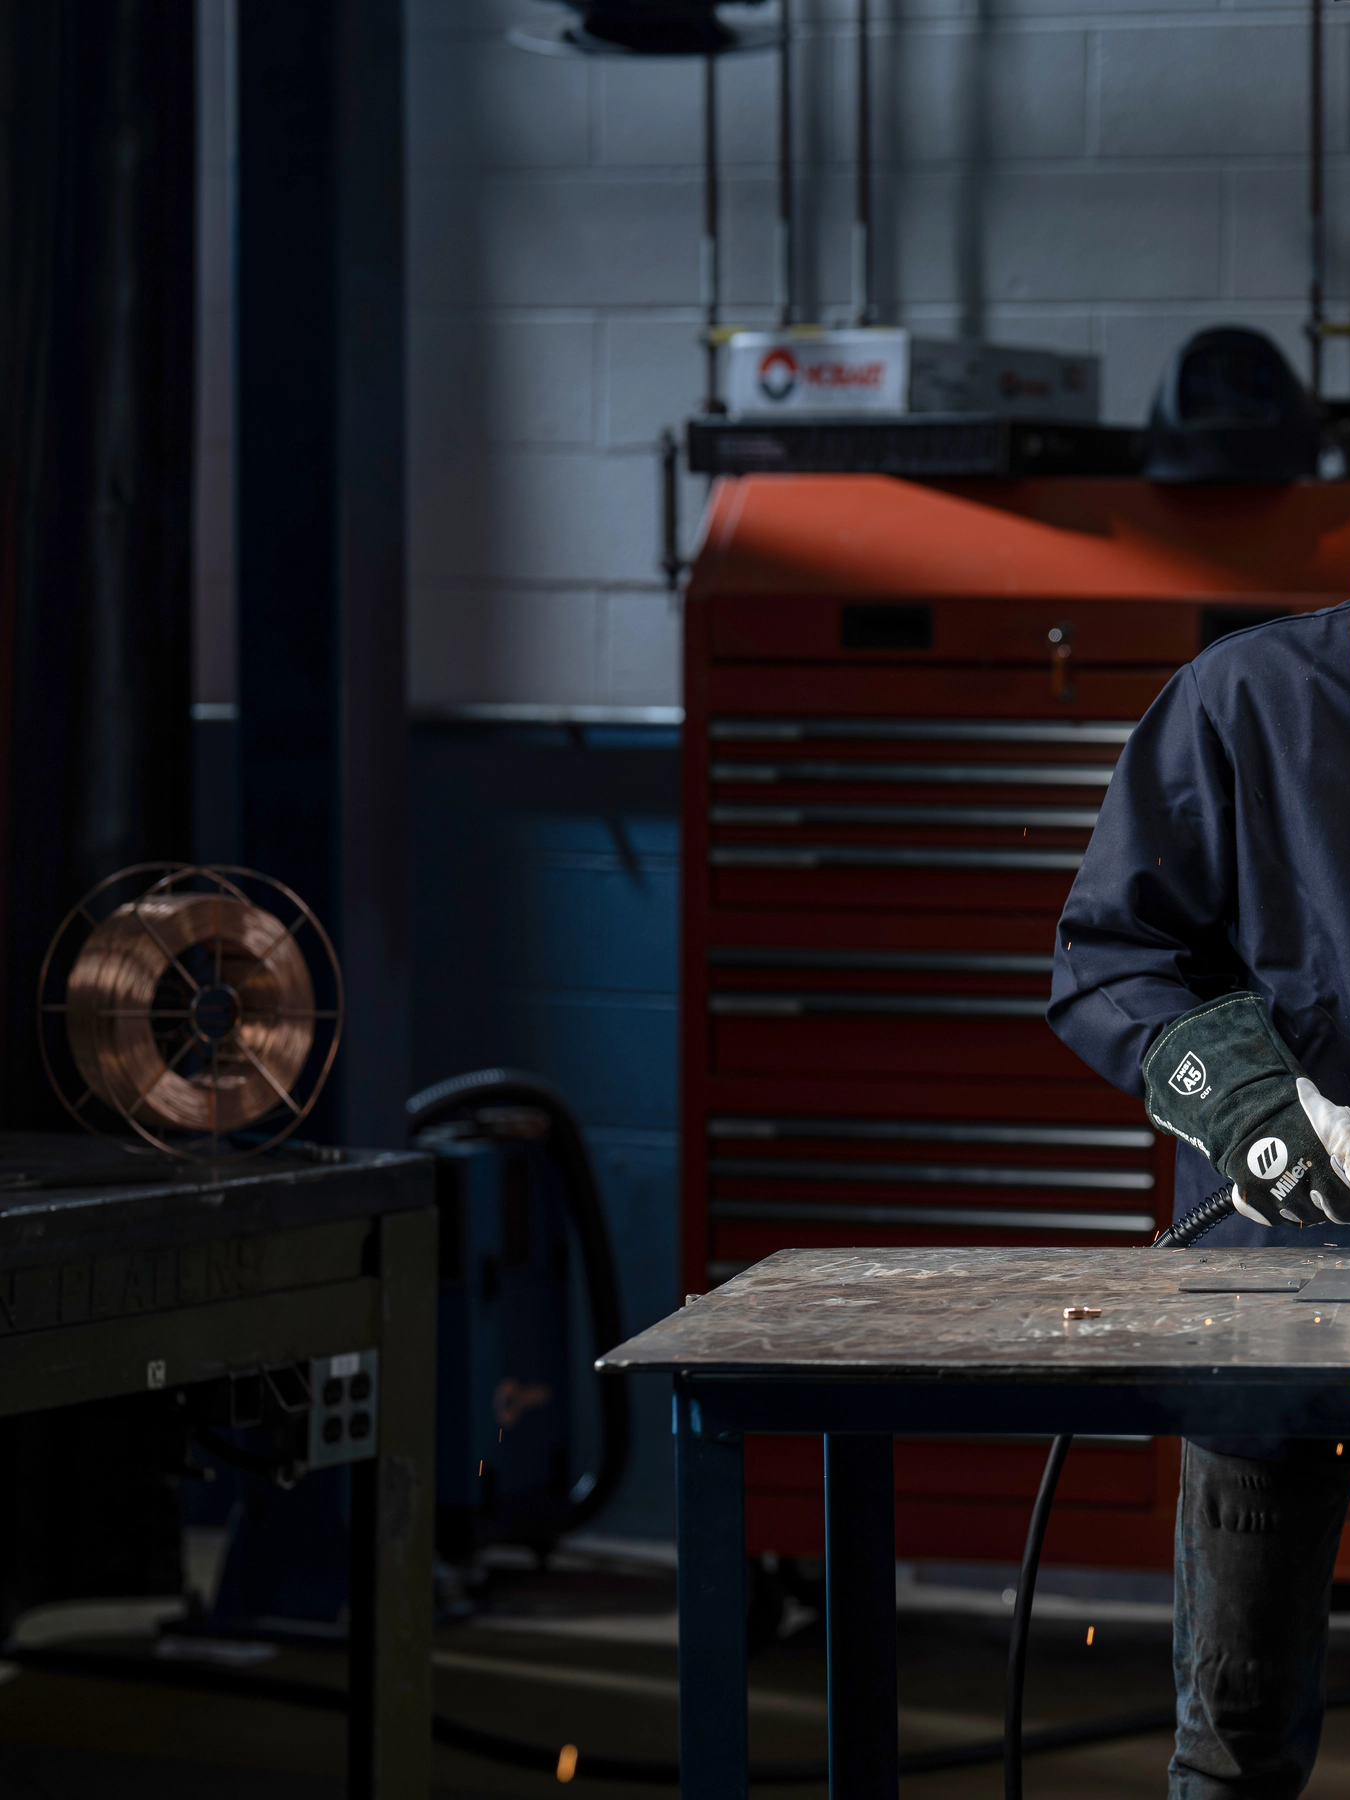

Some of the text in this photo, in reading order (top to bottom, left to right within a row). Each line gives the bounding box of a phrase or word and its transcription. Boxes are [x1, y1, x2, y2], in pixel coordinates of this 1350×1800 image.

[1176, 1060, 1191, 1082] ANSI
[1183, 1066, 1202, 1092] A5
[1200, 1085, 1212, 1100] CUT
[1269, 1157, 1306, 1201] Miller
